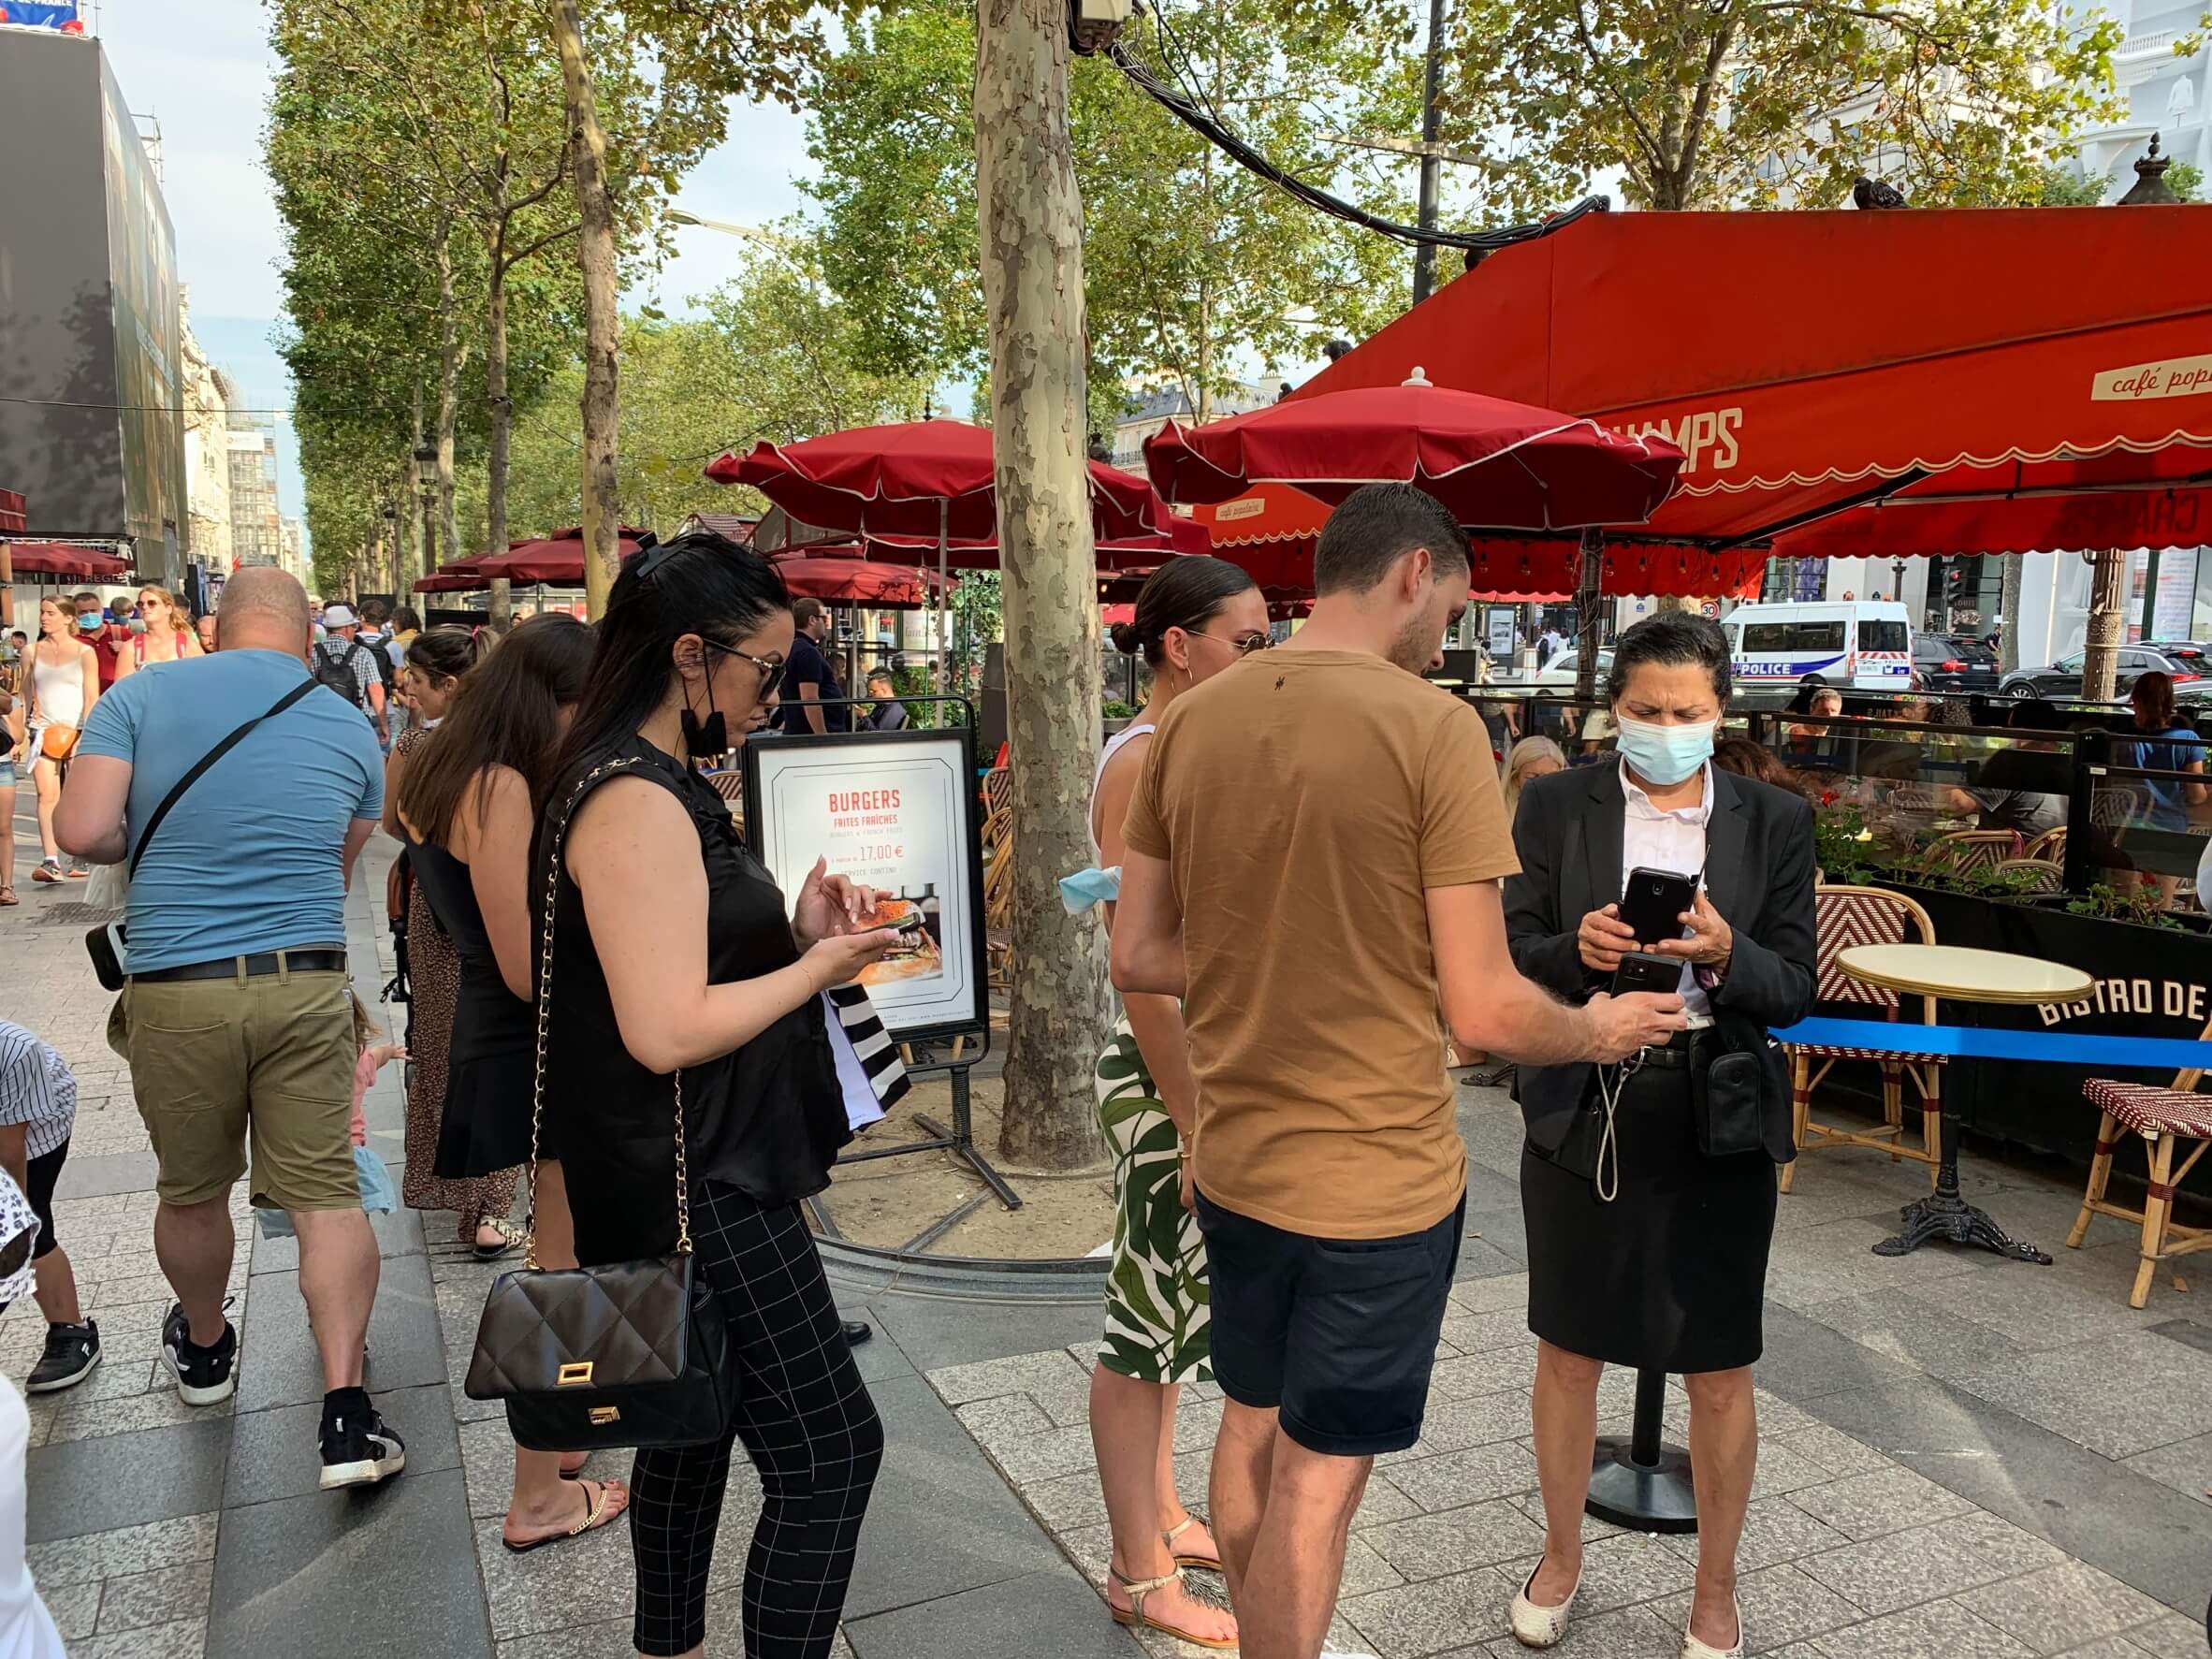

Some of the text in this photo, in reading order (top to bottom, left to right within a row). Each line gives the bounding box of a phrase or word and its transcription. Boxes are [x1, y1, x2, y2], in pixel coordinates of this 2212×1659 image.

[2111, 367, 2212, 398] café pop
[1702, 605, 1715, 615] 30
[1741, 663, 1791, 675] POLICE
[829, 790, 900, 812] BURGERS
[834, 817, 860, 828] FRITES
[860, 844, 892, 862] 17,00
[895, 845, 905, 858] €
[2162, 981, 2207, 1021] DE
